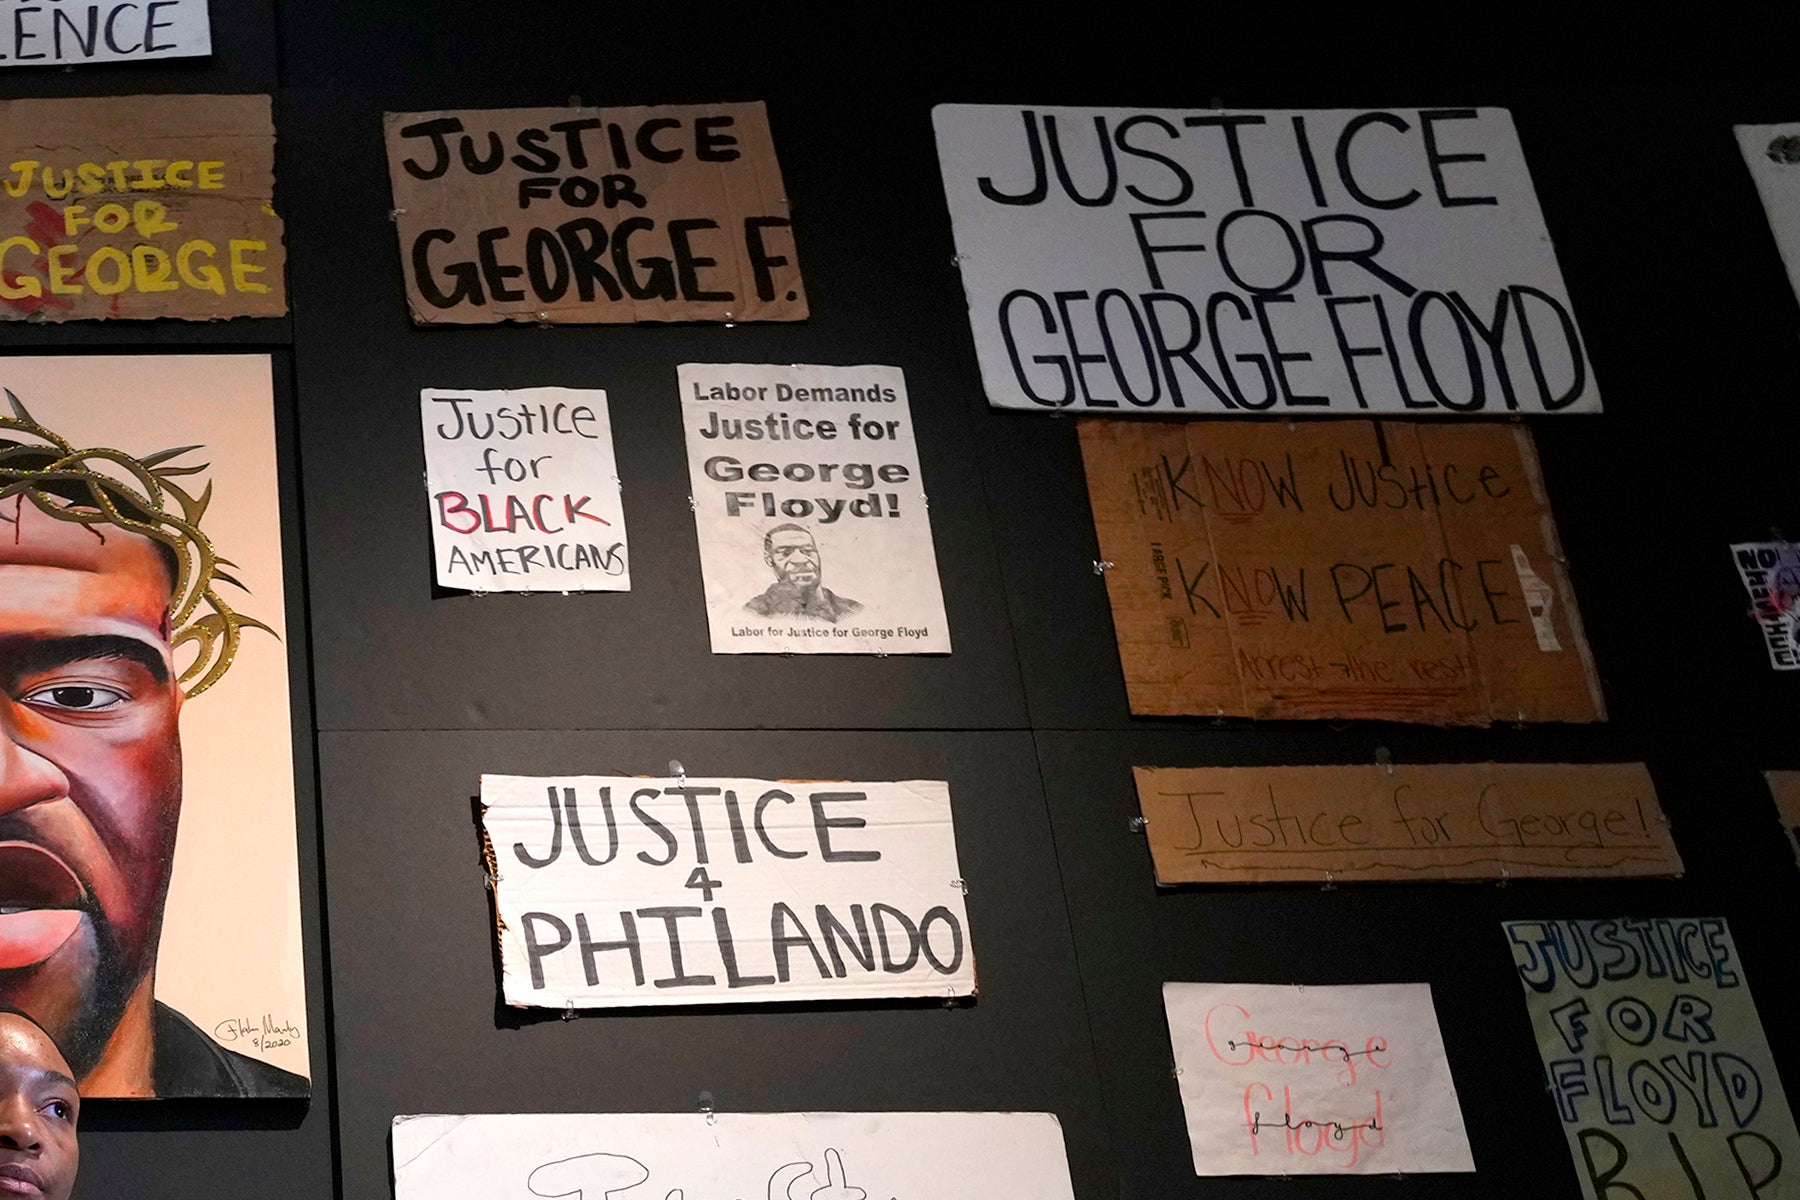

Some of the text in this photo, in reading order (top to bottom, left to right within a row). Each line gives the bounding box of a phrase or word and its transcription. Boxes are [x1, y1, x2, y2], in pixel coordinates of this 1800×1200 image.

[401, 115, 741, 180] JUSTICE
[977, 109, 1498, 210] JUSTICE
[4, 160, 225, 198] JUSTICE
[518, 175, 646, 209] FOR
[64, 201, 179, 238] FOR
[412, 217, 797, 308] GEORGE F.
[1130, 209, 1420, 296] FOR
[998, 286, 1586, 412] GEORGE FLOYD
[693, 381, 897, 403] Labor Demands
[699, 411, 899, 442] Justice for
[476, 446, 553, 486] for
[703, 456, 911, 488] George
[1160, 451, 1307, 514] KNOW
[438, 491, 611, 535] BLACK
[726, 493, 901, 524] Floyd!
[447, 542, 625, 577] AMERICANS
[1175, 556, 1522, 635] KNOW PEACE
[731, 626, 929, 642] Labor for Justice for George Floyd
[513, 785, 882, 870] JUSTICE
[1157, 783, 1652, 862] Justice for George!
[684, 865, 723, 904] 4
[520, 900, 963, 990] PHILANDO
[1509, 917, 1739, 994] JUSTICE
[1205, 1003, 1395, 1088] George
[1549, 993, 1716, 1053] FOR
[1550, 1050, 1763, 1129] FLOYD
